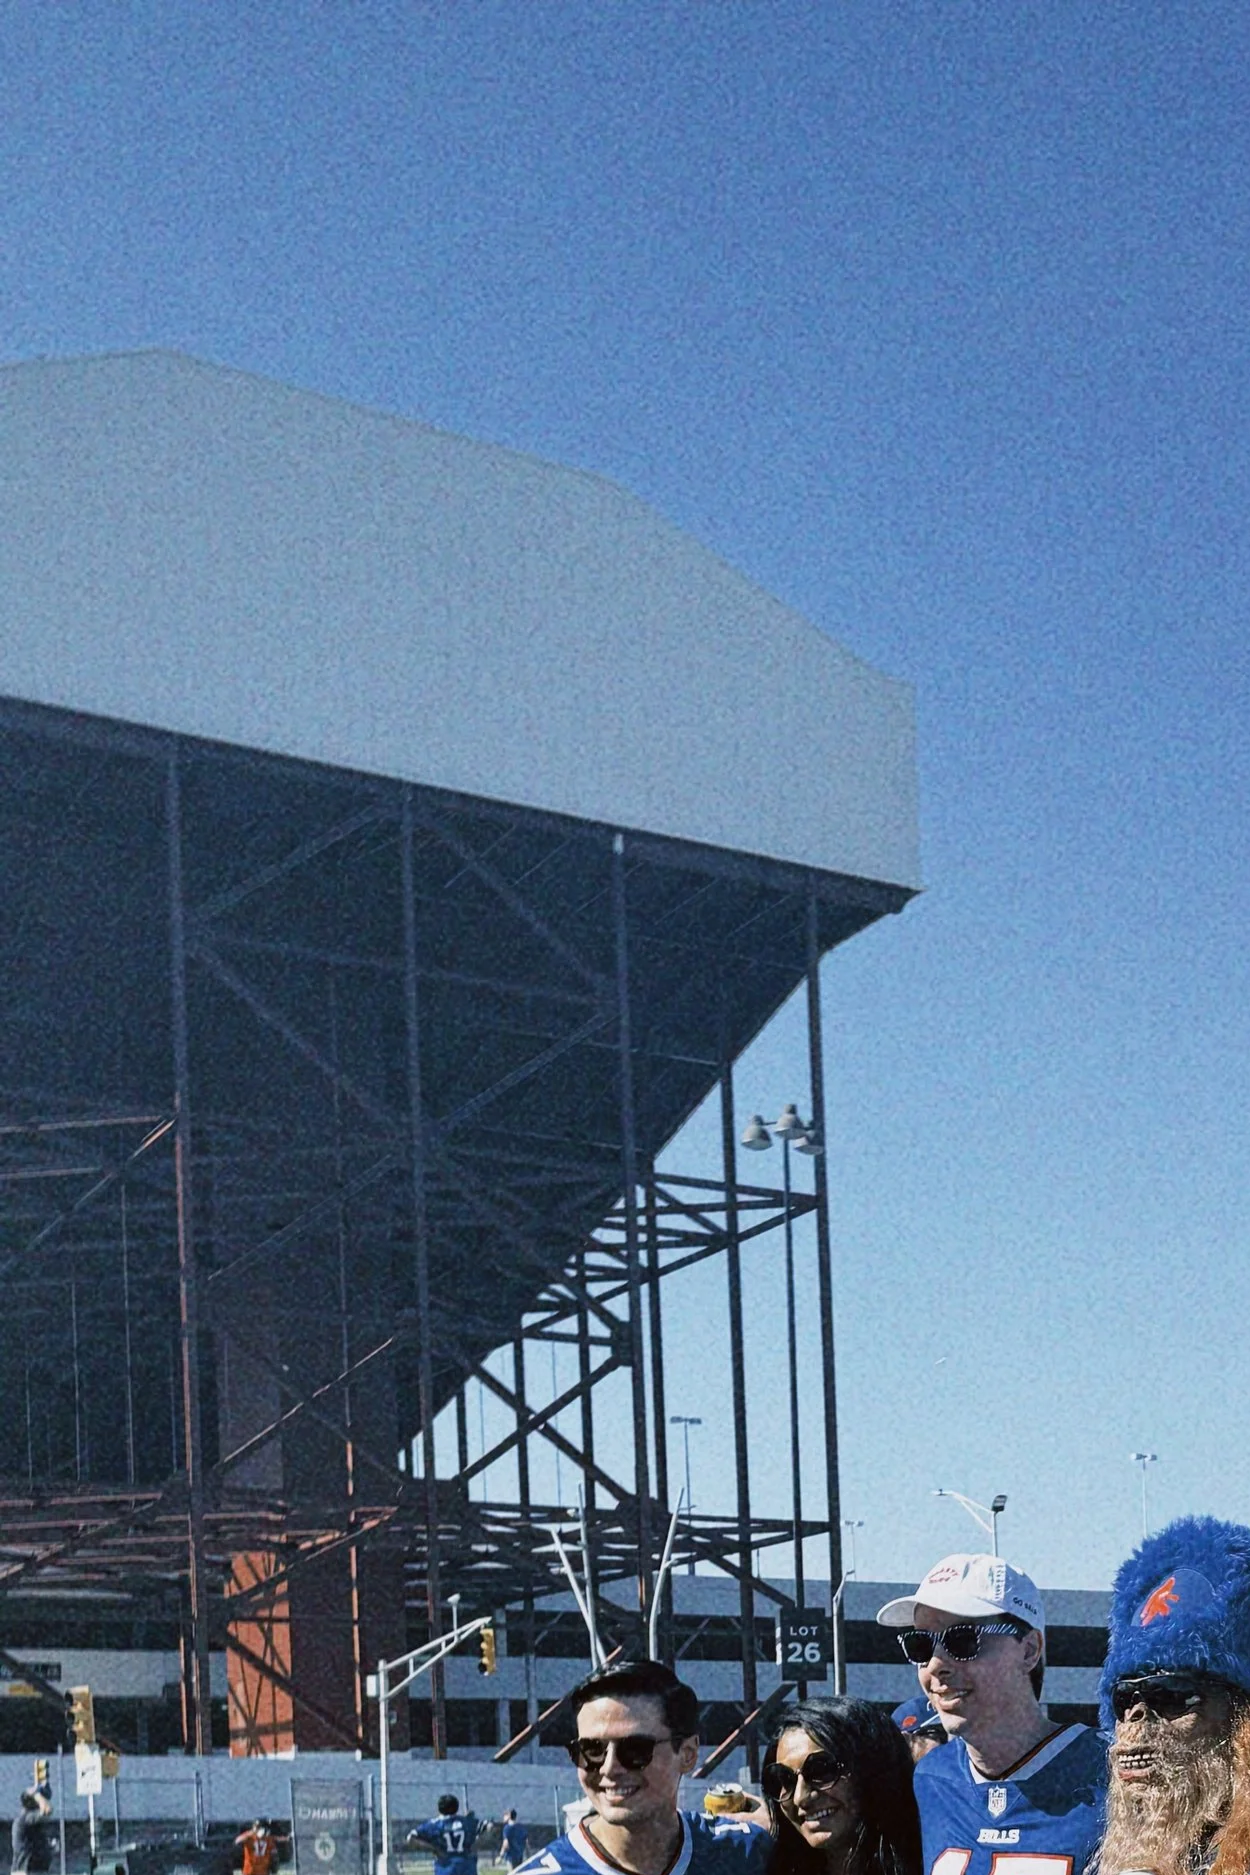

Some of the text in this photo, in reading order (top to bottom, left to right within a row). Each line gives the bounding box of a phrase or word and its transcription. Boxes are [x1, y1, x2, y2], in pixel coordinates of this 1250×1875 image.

[790, 1626, 818, 1636] LOT
[787, 1642, 821, 1663] 26
[442, 1830, 465, 1853] 17
[976, 1828, 1020, 1844] BILLS
